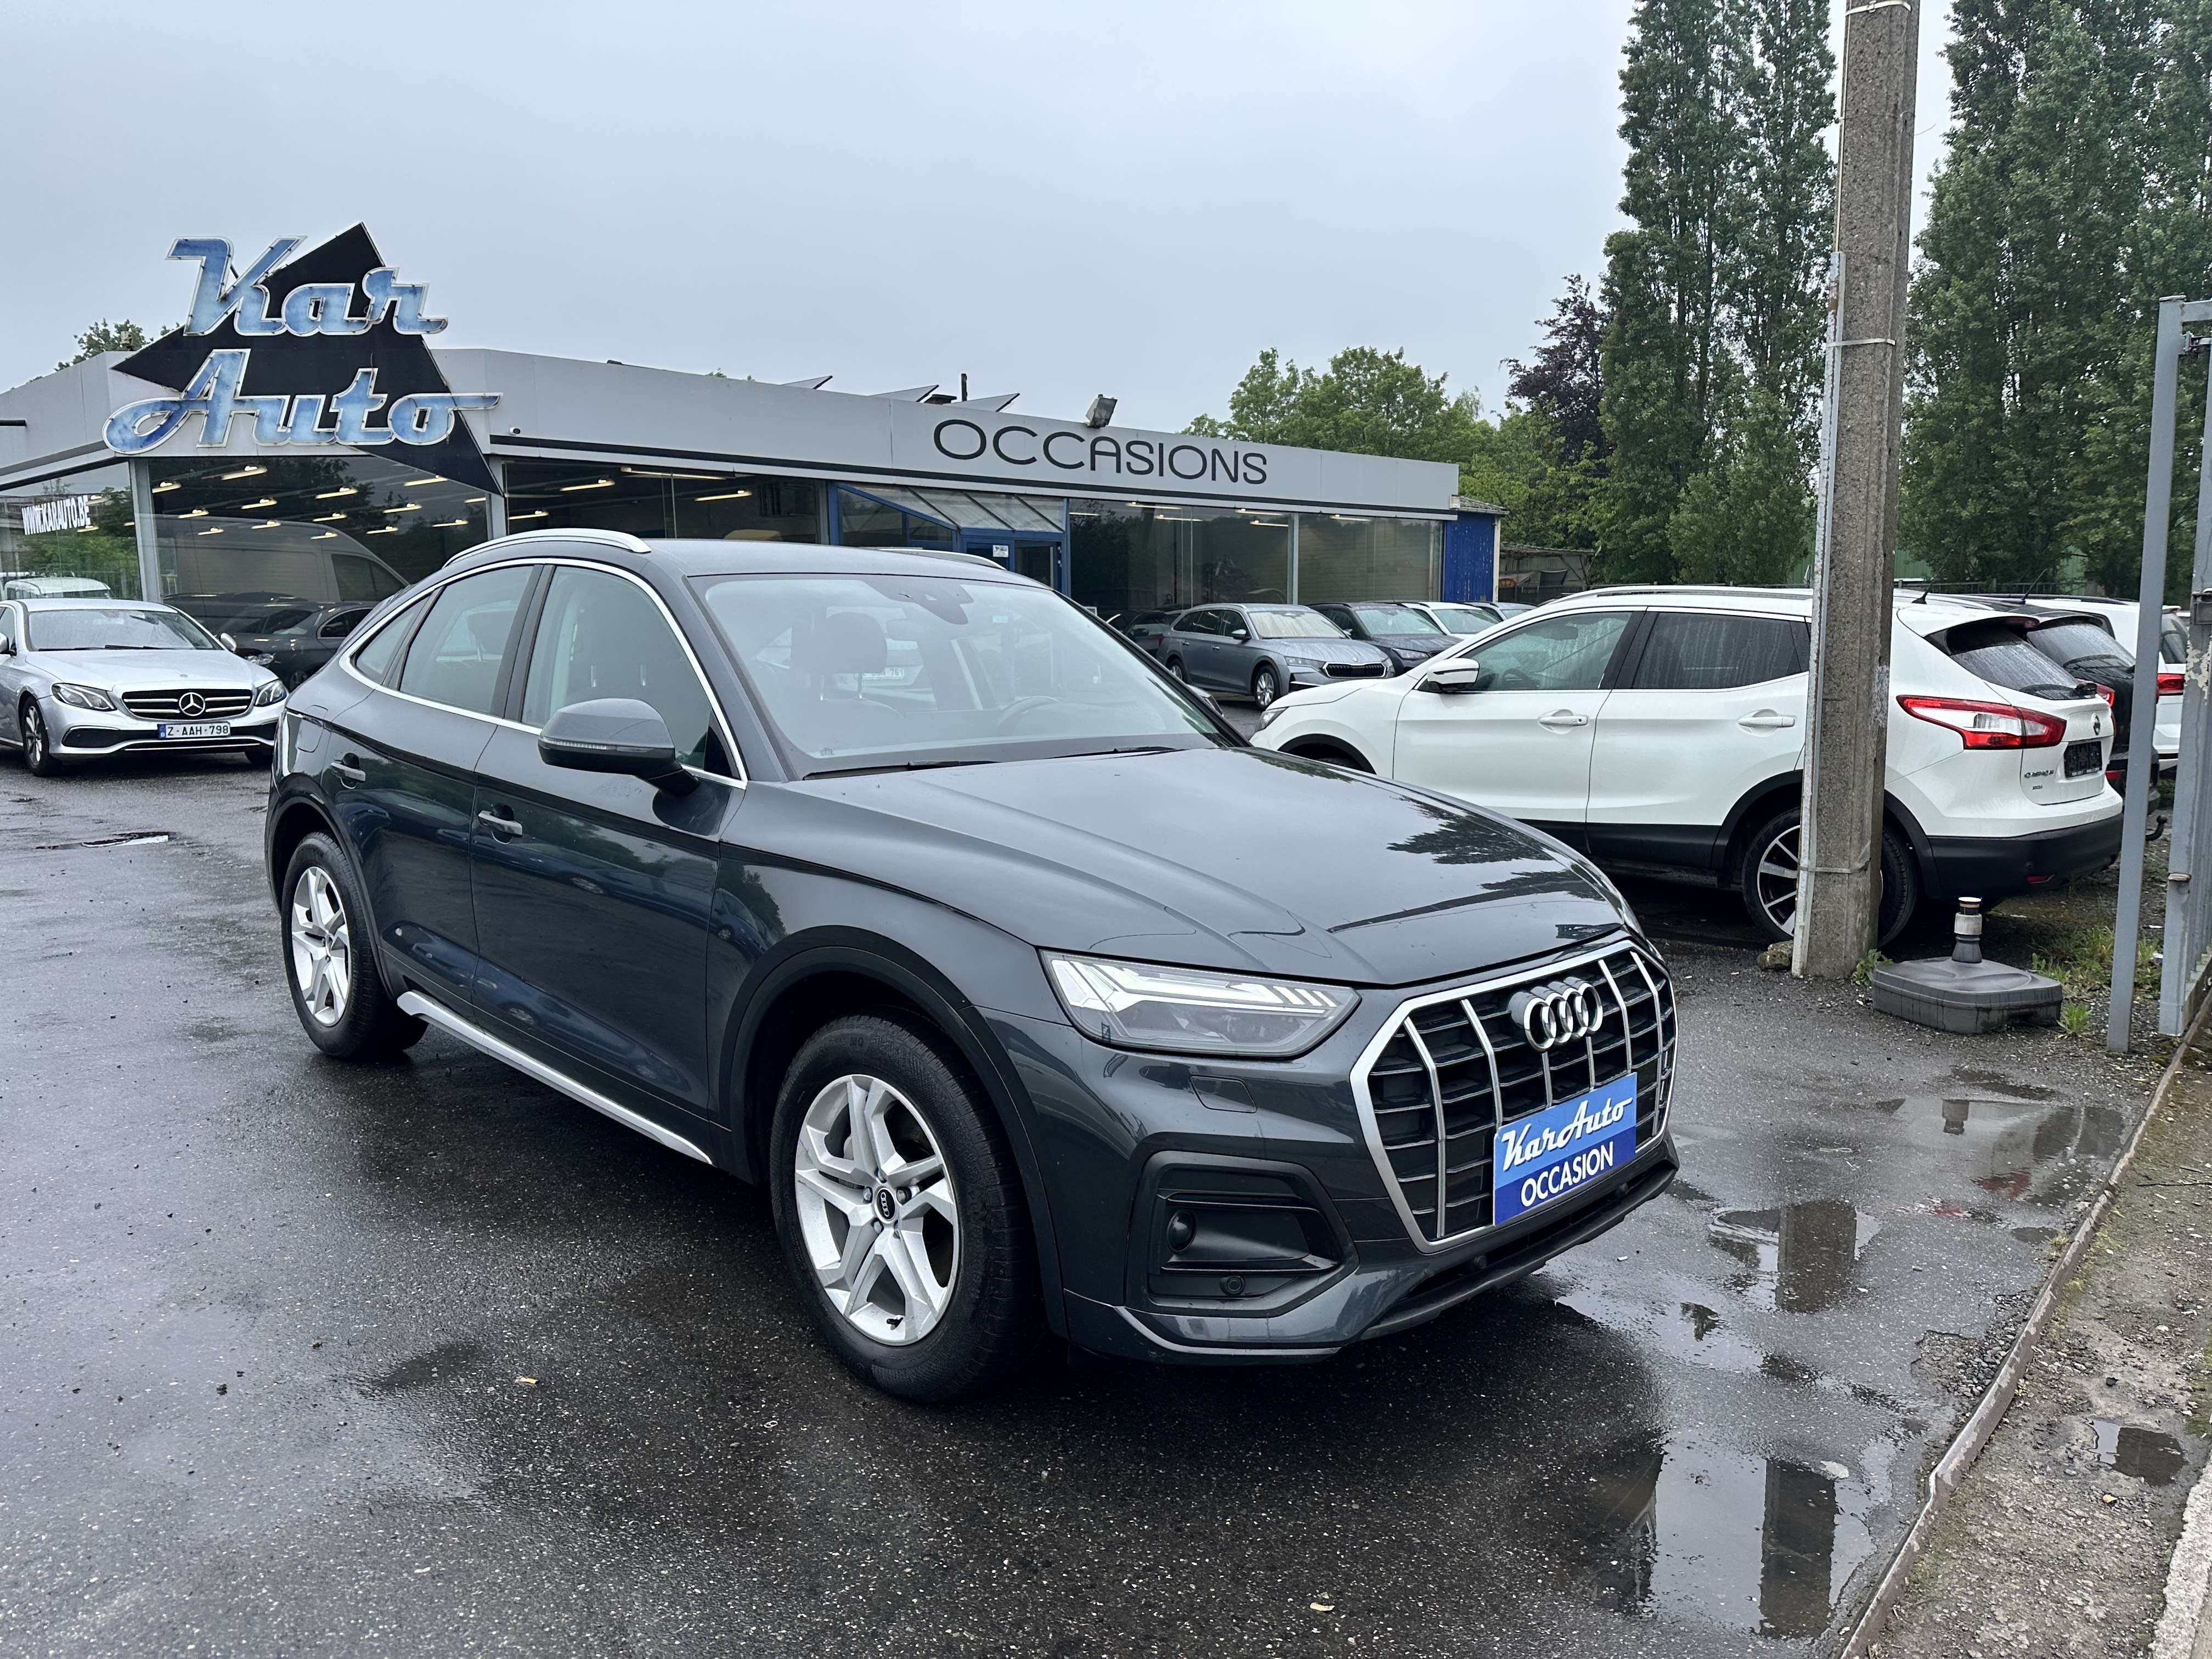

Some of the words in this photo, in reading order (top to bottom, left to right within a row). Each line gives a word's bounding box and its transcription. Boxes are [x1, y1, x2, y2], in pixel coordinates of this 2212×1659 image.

[165, 235, 449, 337] Kar
[101, 348, 503, 455] Auto
[933, 419, 1267, 484] OCCASIONS
[1521, 1142, 1613, 1207] OCCASION
